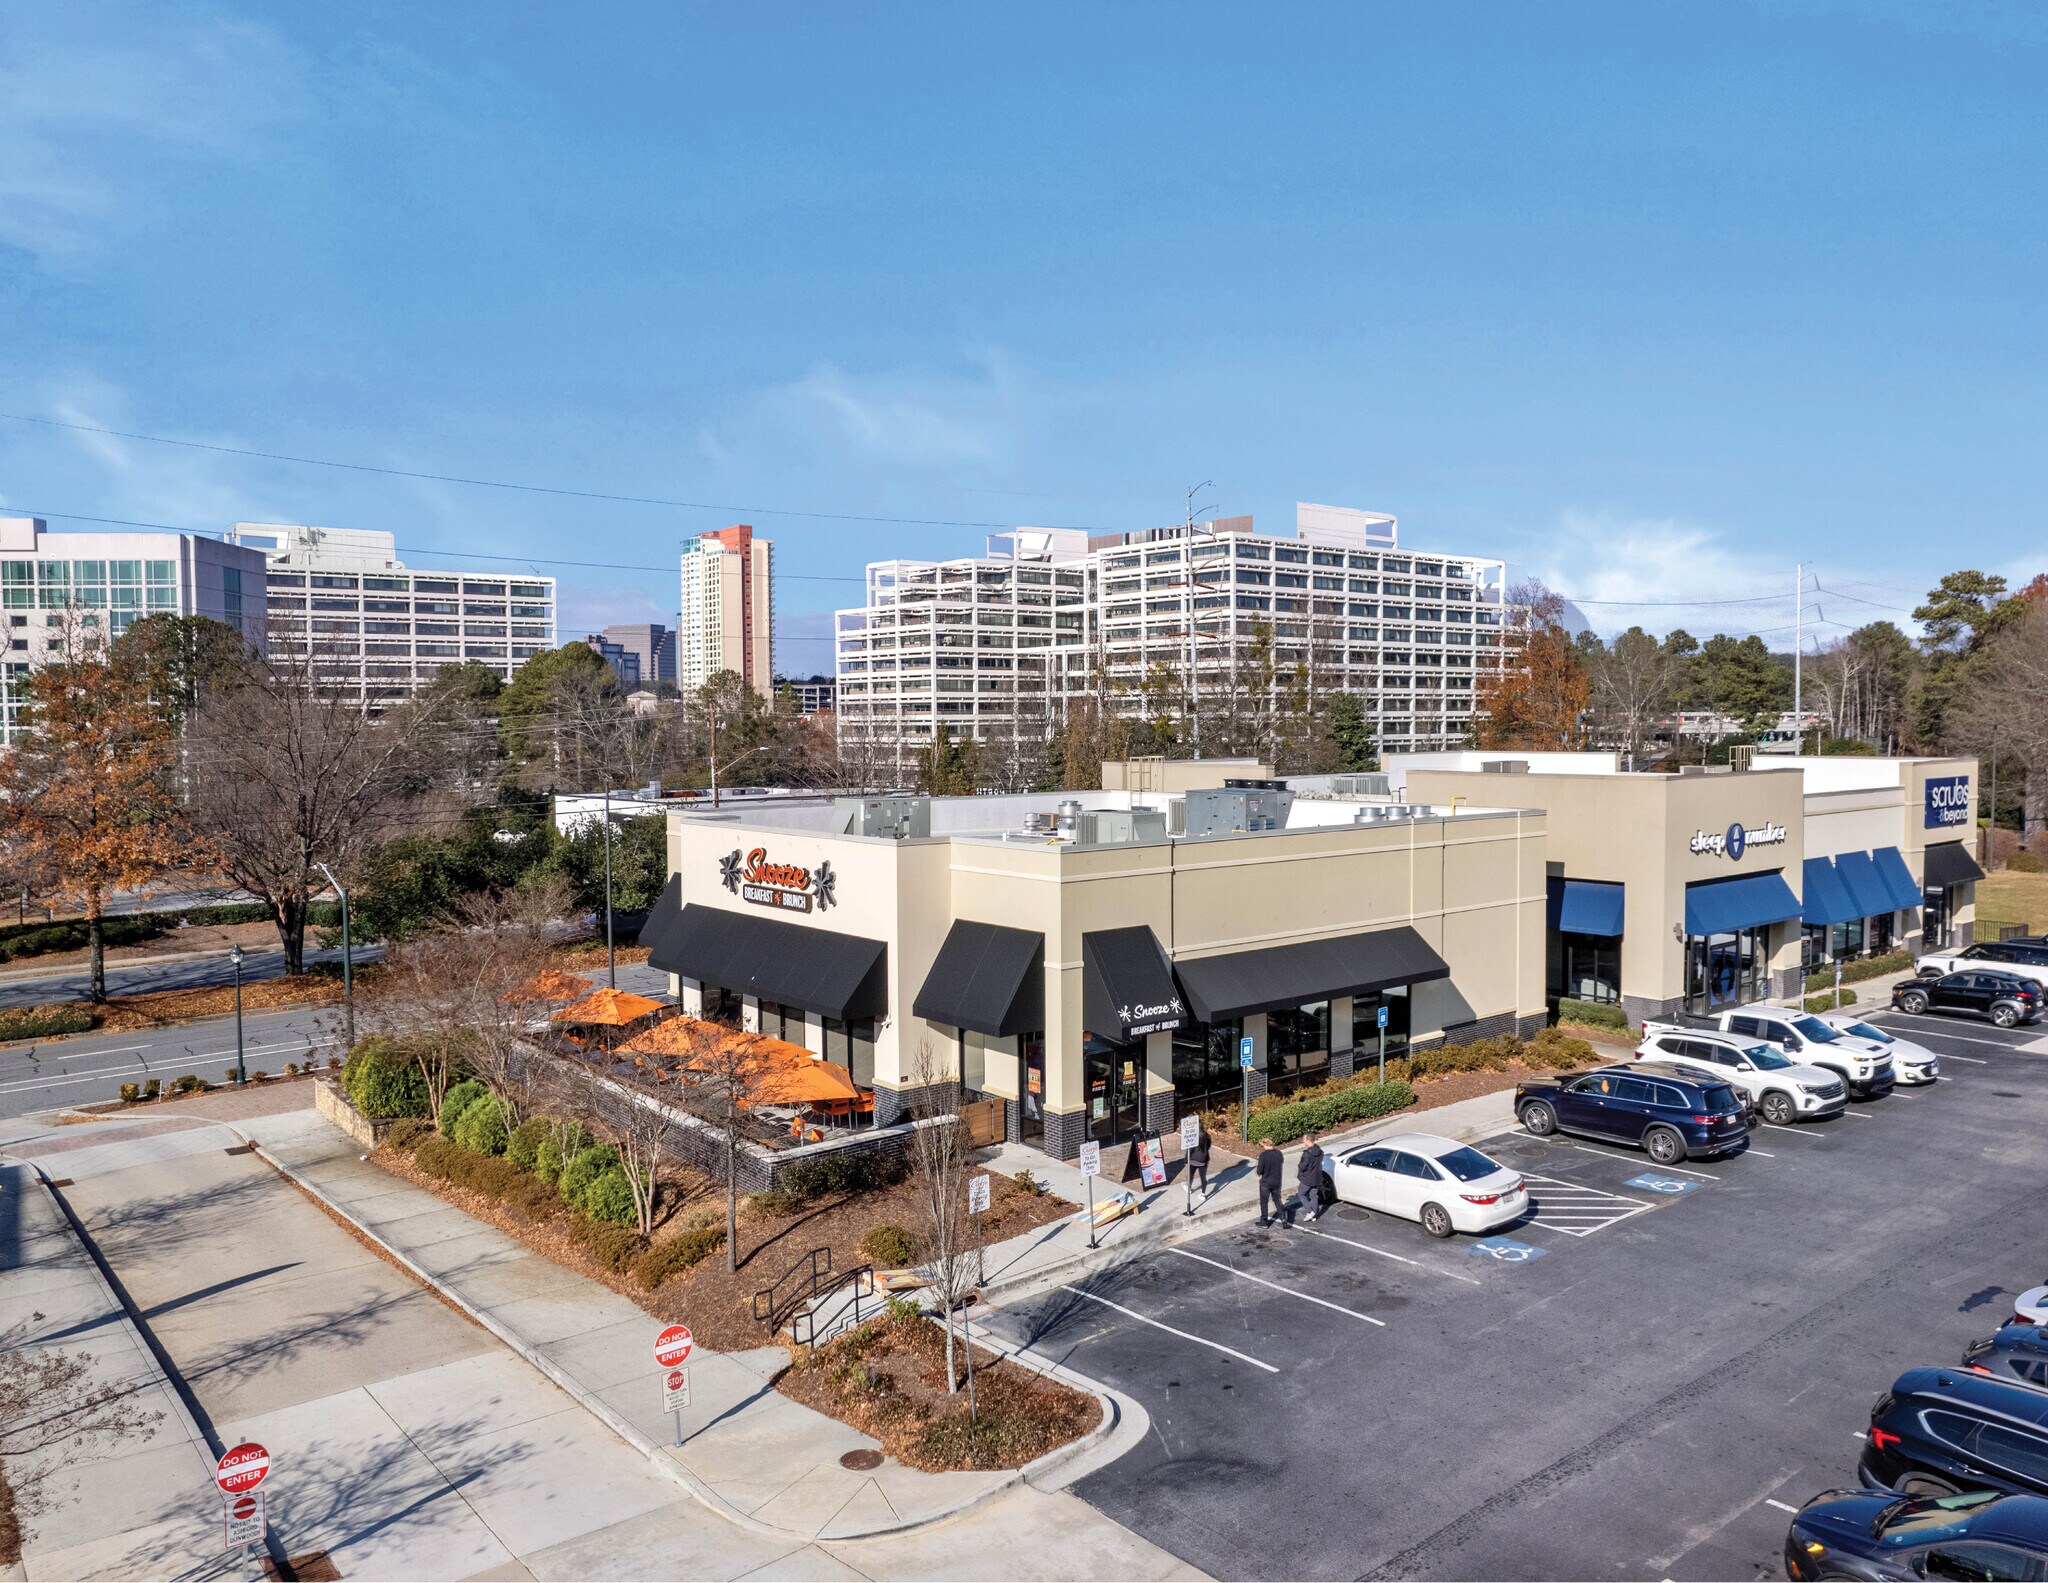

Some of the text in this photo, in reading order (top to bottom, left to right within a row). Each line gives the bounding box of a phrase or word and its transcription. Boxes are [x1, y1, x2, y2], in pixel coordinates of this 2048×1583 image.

[1932, 778, 1969, 808] scrubs
[1691, 822, 1786, 855] sleep number
[742, 848, 809, 890] Snooze
[744, 886, 807, 909] BREAKFAST BRUNCH
[1133, 1004, 1170, 1019] Snooze
[1130, 1019, 1180, 1036] BREAKFAST BRUNCH
[658, 1331, 687, 1346] DO NOT
[661, 1348, 687, 1362] ENTER
[667, 1375, 684, 1387] STOP
[223, 1449, 264, 1468] DO NOT
[226, 1469, 261, 1487] ENTER
[229, 1530, 261, 1544] DUNWOODY
